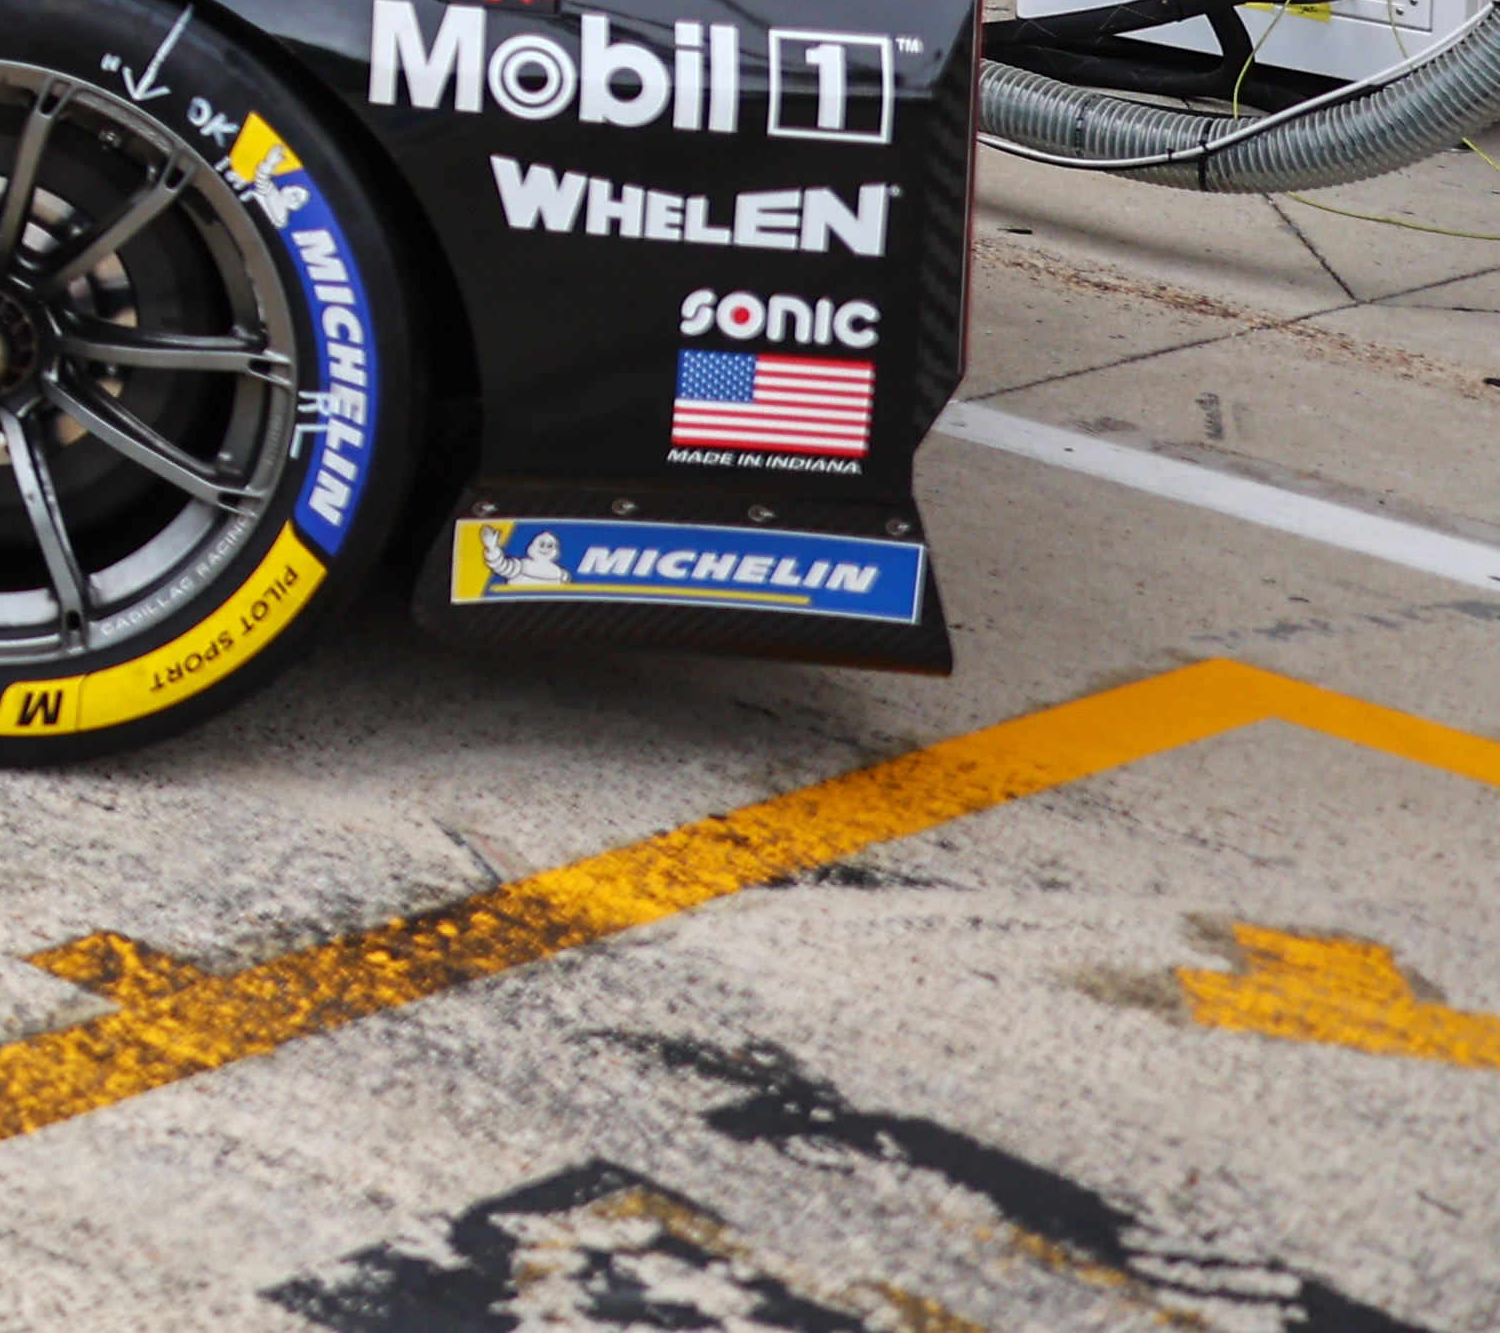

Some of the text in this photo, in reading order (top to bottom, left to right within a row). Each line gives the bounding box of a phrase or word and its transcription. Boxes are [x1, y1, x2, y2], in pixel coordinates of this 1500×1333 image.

[186, 96, 241, 148] OK
[489, 153, 890, 257] WHELEN
[678, 287, 880, 349] SONIC
[290, 228, 375, 527] MICHELIN
[667, 448, 862, 475] MADE IN INDIANA
[576, 545, 881, 595] MICHELIN
[149, 563, 300, 693] PILOT SPORT
[15, 689, 65, 727] M
